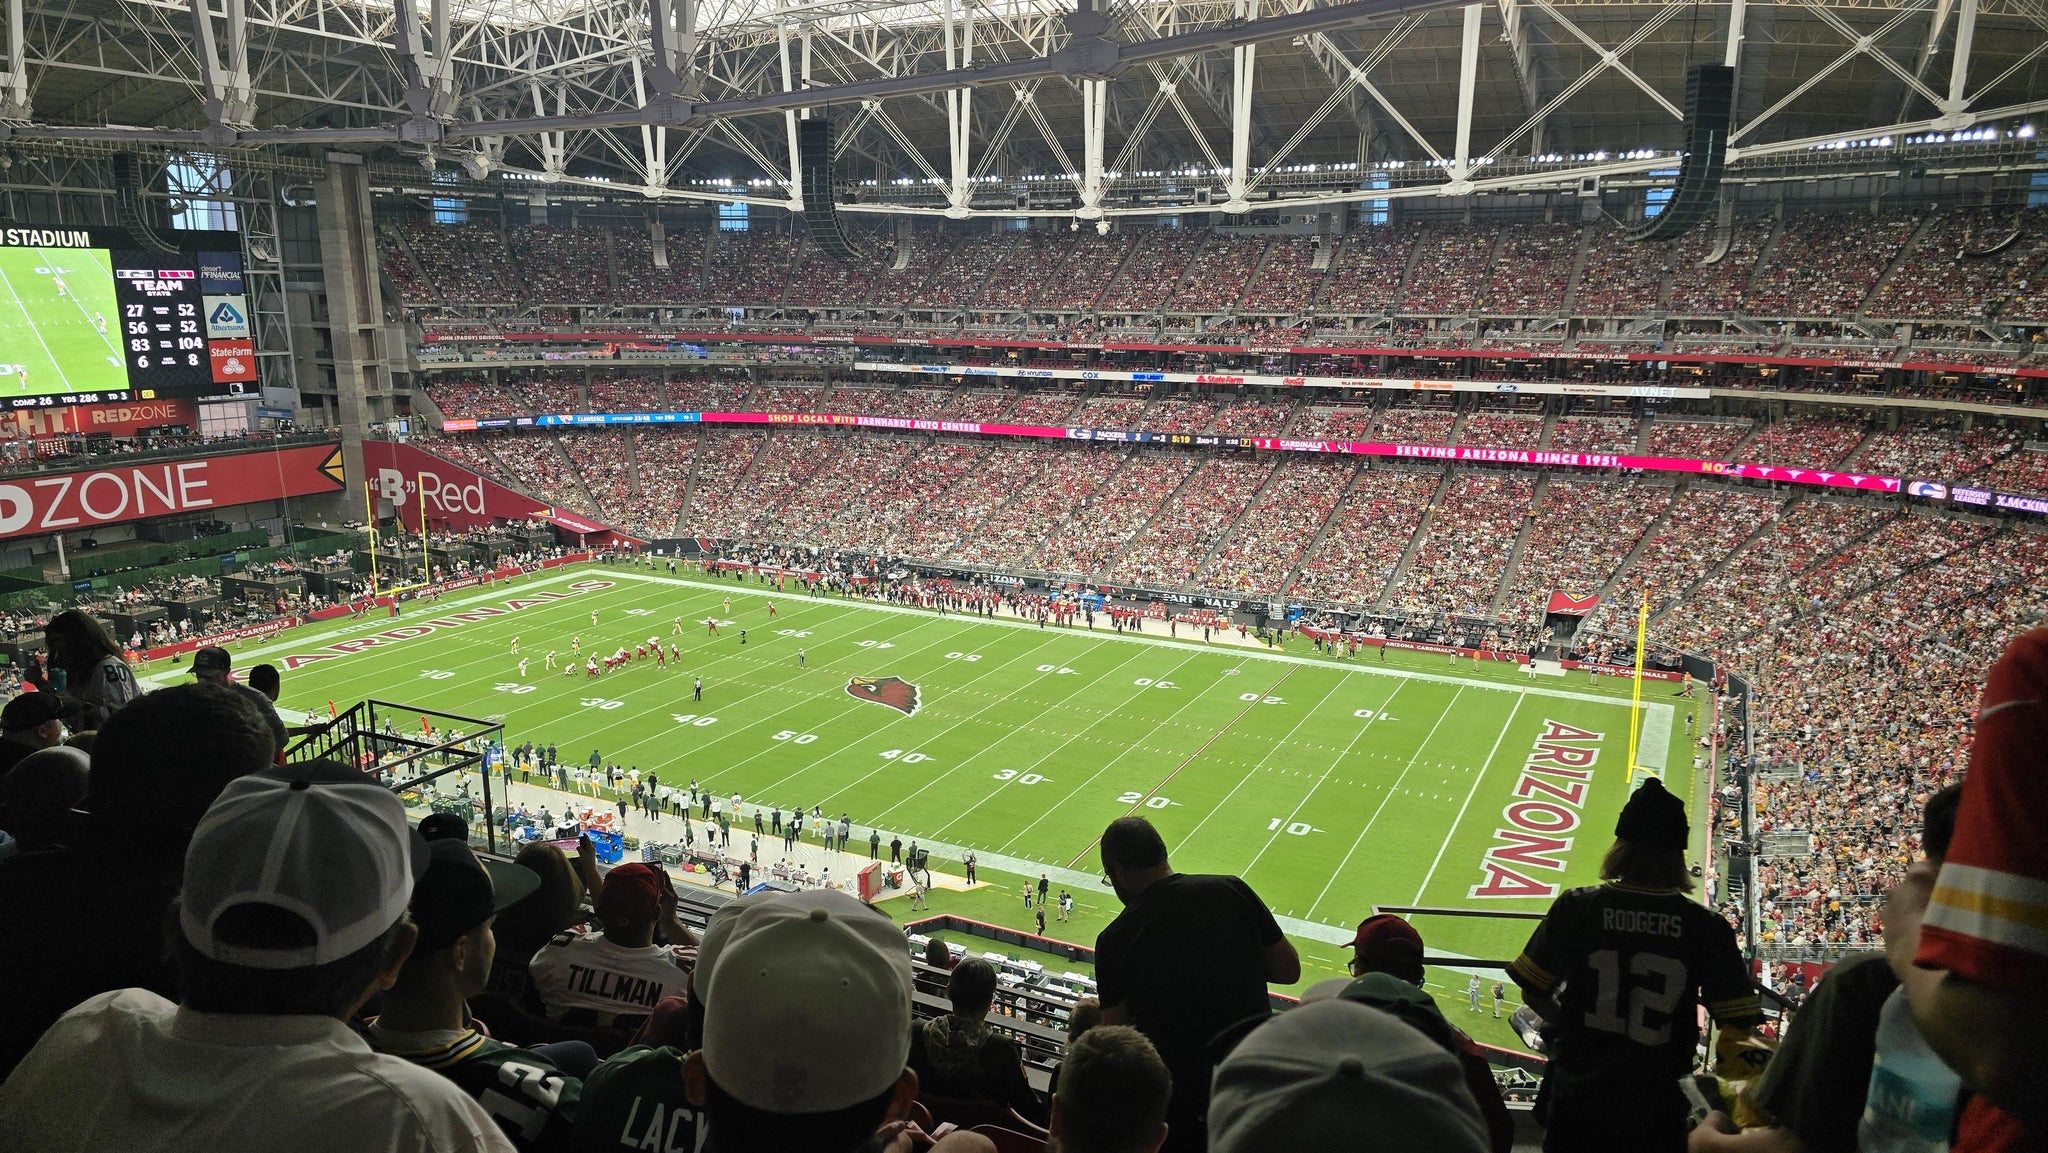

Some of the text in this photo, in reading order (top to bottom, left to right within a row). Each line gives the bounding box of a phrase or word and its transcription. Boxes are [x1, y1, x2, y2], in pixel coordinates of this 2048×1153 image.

[7, 229, 90, 247] STADIUM
[132, 280, 183, 291] TEAM
[126, 304, 144, 317] 27
[178, 304, 195, 316] 52
[128, 321, 148, 334] 56
[180, 320, 198, 333] 52
[131, 338, 150, 352] 83
[178, 337, 204, 350] 104
[138, 355, 149, 368] 6
[188, 354, 199, 366] 8
[1630, 386, 1676, 398] AVNET
[13, 399, 36, 407] COMP
[39, 396, 52, 406] 26
[80, 394, 98, 403] 286
[120, 392, 128, 400] 3
[92, 404, 177, 424] REDZONE
[798, 415, 828, 423] LOCAL
[832, 416, 856, 424] WITH
[858, 417, 911, 428] EARNHARDT
[914, 420, 938, 430] AUTO
[940, 422, 981, 432] CENTERS
[1096, 430, 1126, 438] PACKERS
[1135, 433, 1141, 442] 3
[1172, 436, 1190, 444] 5:19
[1265, 440, 1270, 448] 3
[1396, 446, 1622, 466] SERVING ARIZONA SINCE 1951.
[1952, 488, 1991, 500] DEFENSIVE
[1954, 494, 1988, 505] LEADERS
[986, 574, 1026, 586] IZONA
[1162, 594, 1239, 608] CARNALS
[195, 633, 236, 648] ARIZONA
[1416, 645, 1454, 654] CARDINAL
[944, 652, 983, 662] 50
[103, 663, 129, 683] 80
[1578, 664, 1668, 679] ARIONA CARINALS
[492, 682, 537, 694] 20
[1133, 678, 1176, 690] 30
[580, 698, 624, 710] 30
[1238, 693, 1283, 705] 20
[675, 712, 718, 728] 40
[772, 730, 819, 745] 50
[878, 749, 926, 764] 40
[993, 769, 1043, 786] 30
[1116, 791, 1171, 809] 20
[1466, 718, 1605, 899] ARIZONA
[1266, 817, 1312, 836] 10
[1603, 907, 1682, 939] RODGERS
[567, 963, 663, 1007] TILLMAN
[1584, 949, 1688, 1047] 12
[476, 1060, 566, 1144] 12
